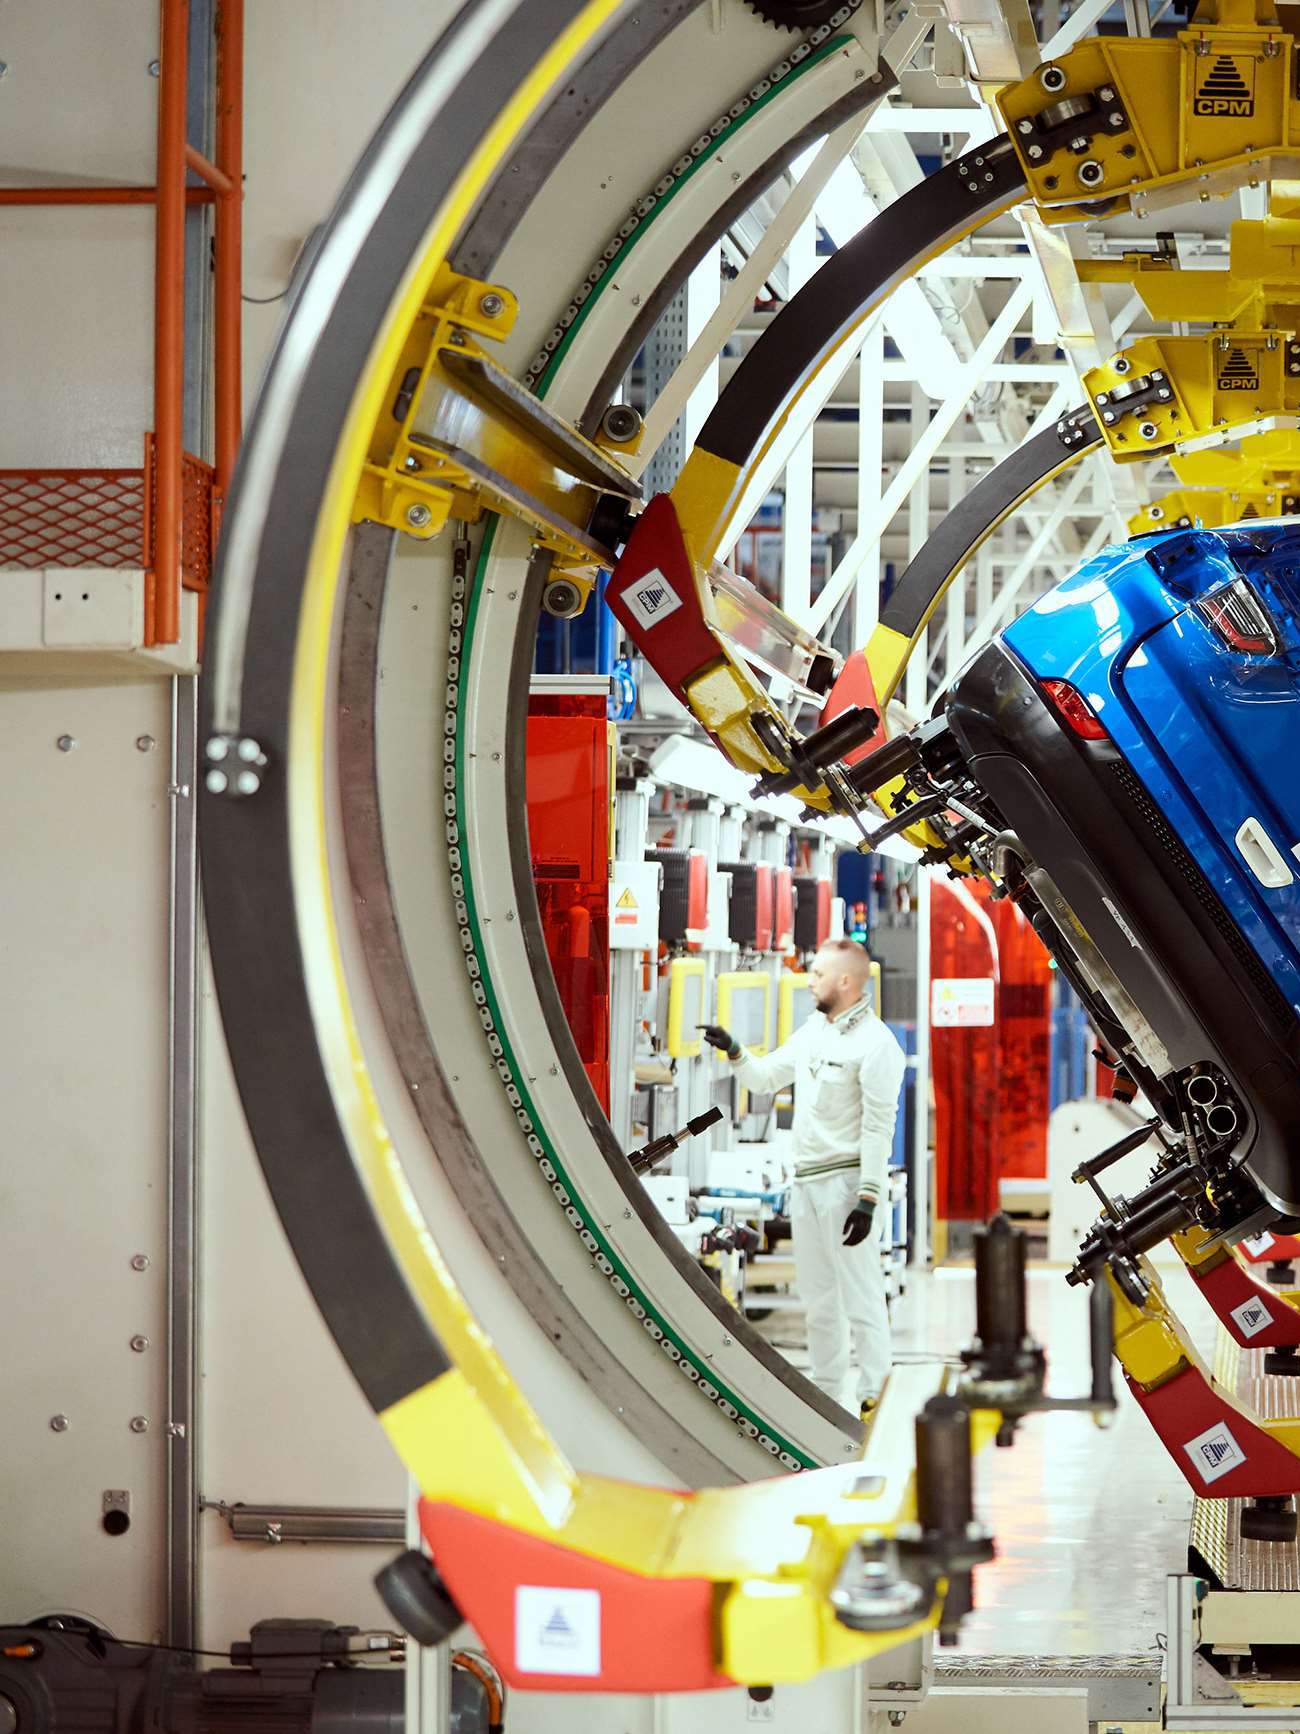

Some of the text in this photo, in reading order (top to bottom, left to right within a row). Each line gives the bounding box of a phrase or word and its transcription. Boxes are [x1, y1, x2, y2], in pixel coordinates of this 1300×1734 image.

[1197, 100, 1251, 115] CPM
[1219, 379, 1257, 389] CPM
[639, 592, 655, 612] CPM
[1202, 1446, 1218, 1466] CPM
